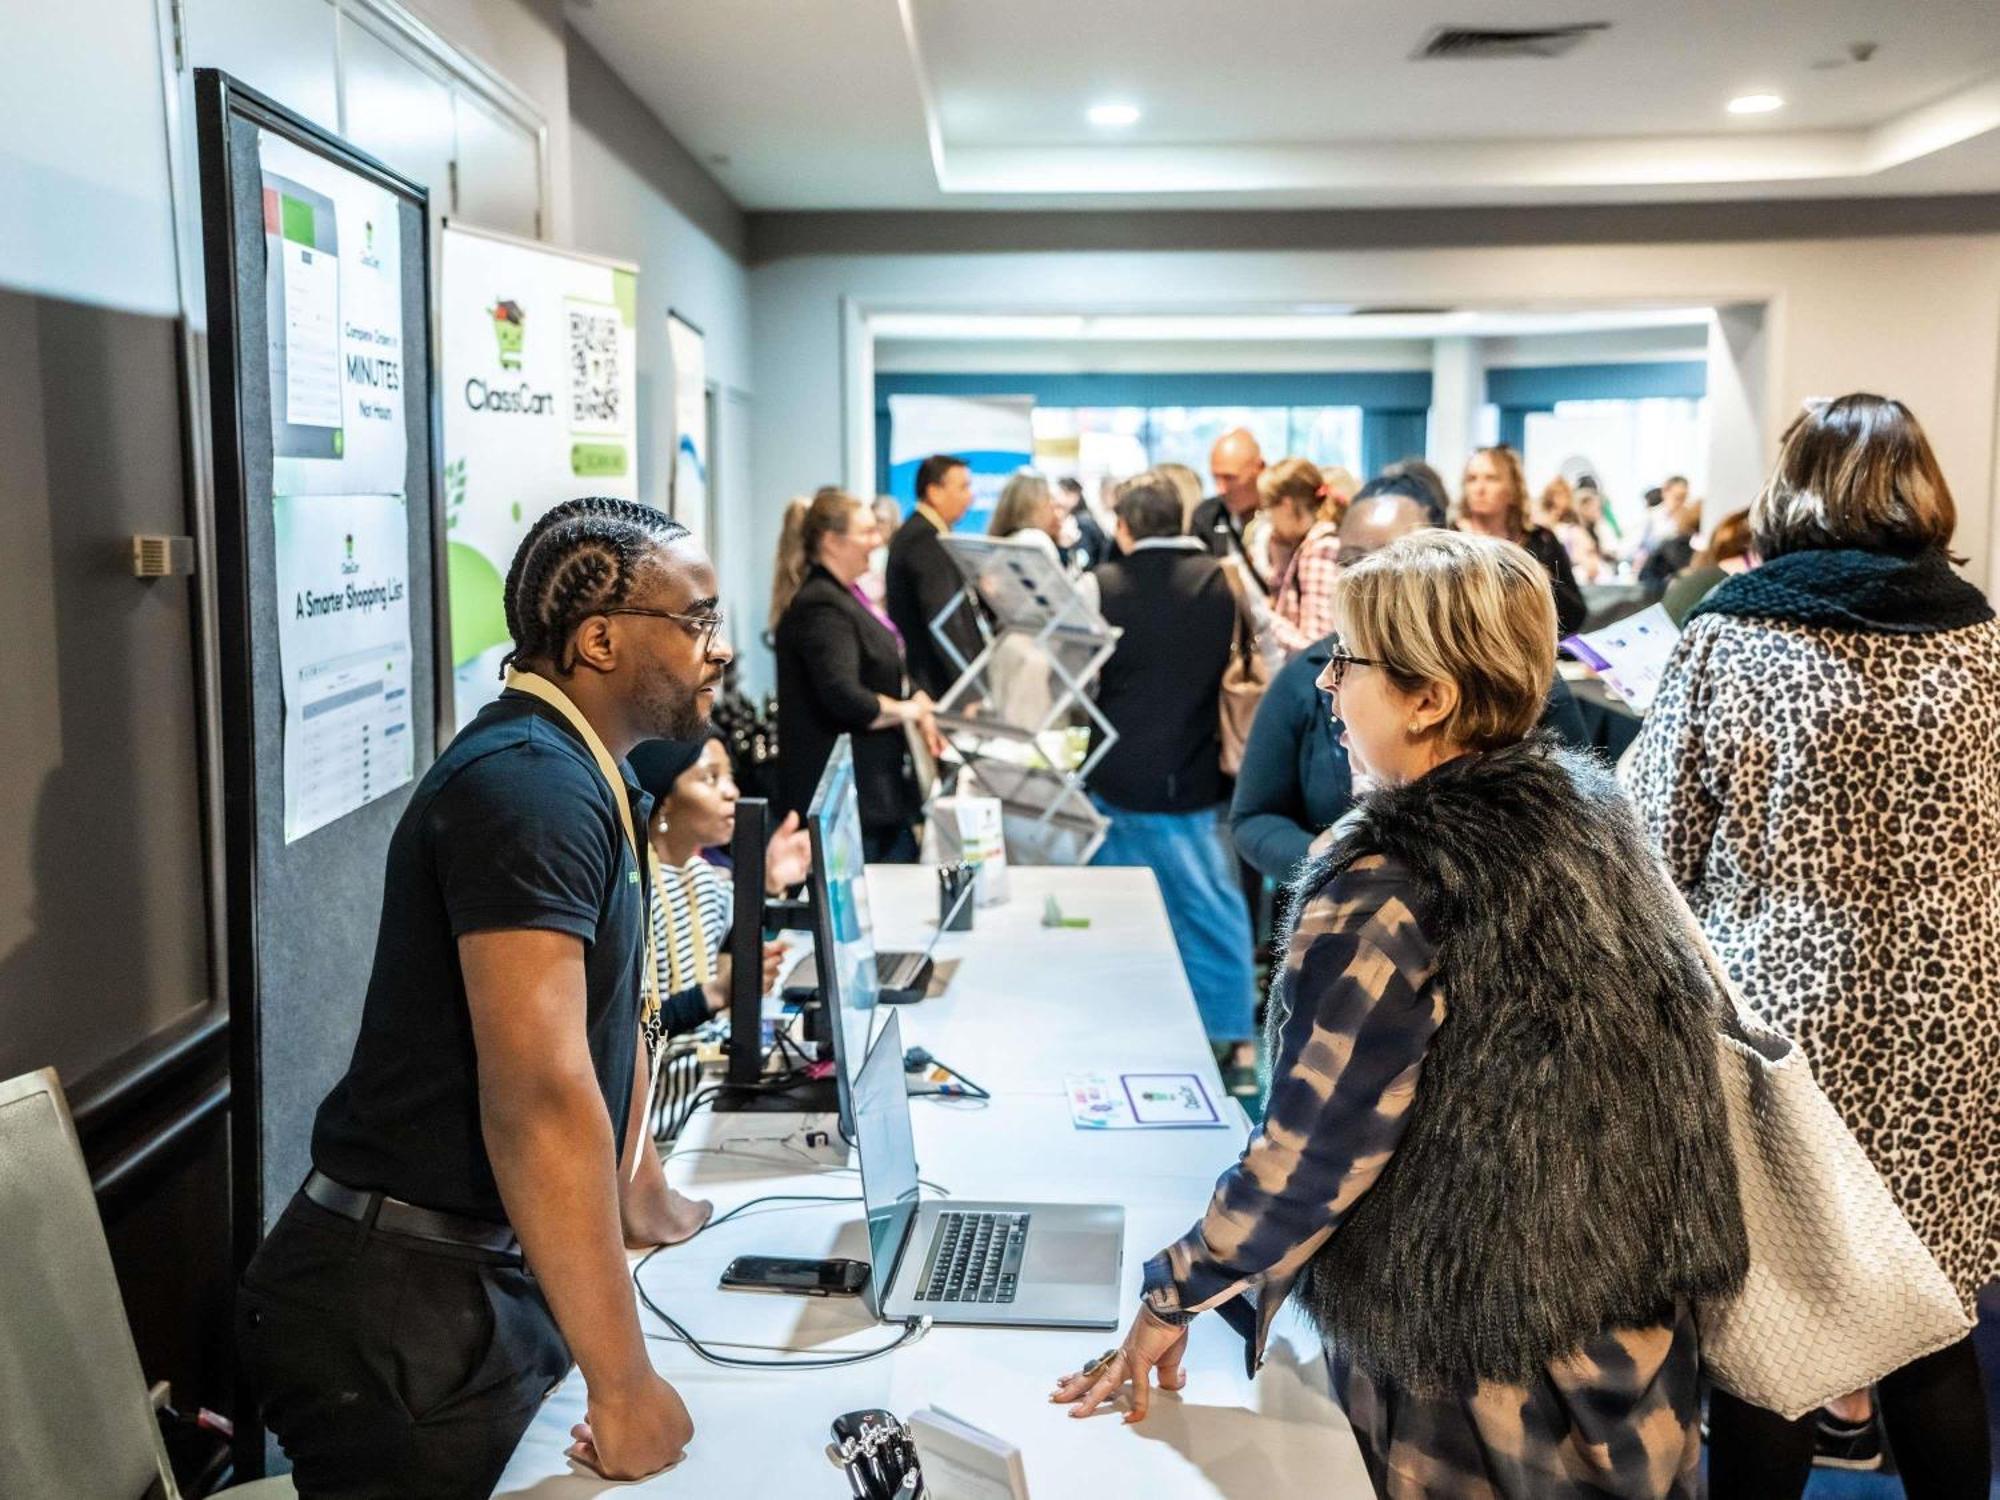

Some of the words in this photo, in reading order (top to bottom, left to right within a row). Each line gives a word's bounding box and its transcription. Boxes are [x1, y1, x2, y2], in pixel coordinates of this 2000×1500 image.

[346, 353, 400, 390] MINUTES
[465, 378, 554, 415] ClassCart
[296, 591, 304, 620] A
[306, 589, 344, 618] Smarter
[346, 581, 386, 613] Shopping
[388, 576, 403, 602] List
